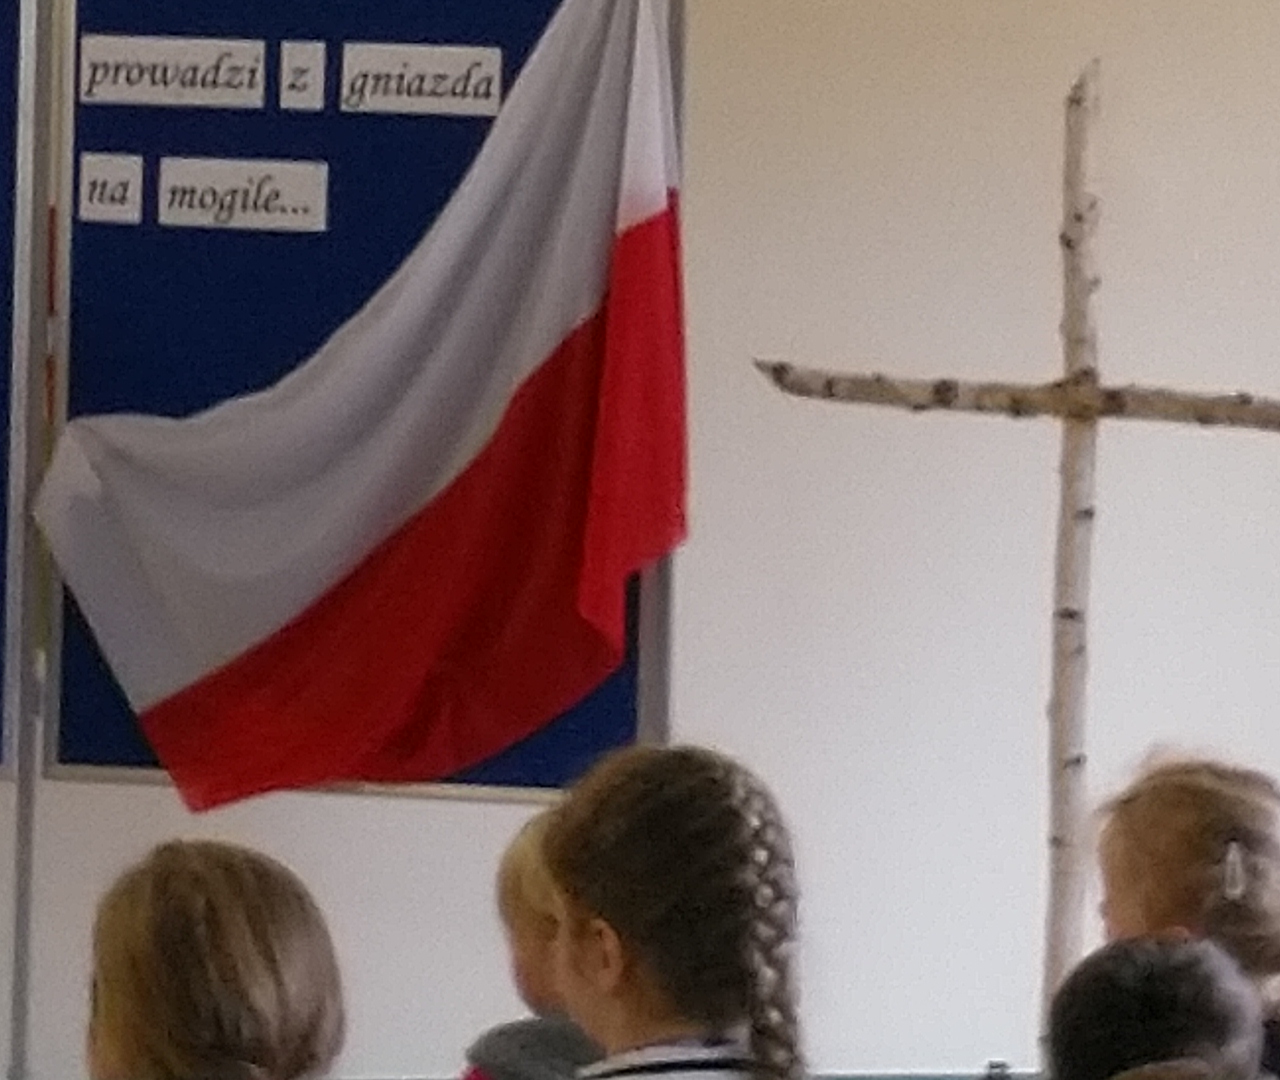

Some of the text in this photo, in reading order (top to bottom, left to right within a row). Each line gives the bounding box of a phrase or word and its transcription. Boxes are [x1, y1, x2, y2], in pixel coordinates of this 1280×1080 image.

[86, 52, 494, 107] prowadzi z gniazda
[87, 176, 311, 222] na mogile...
